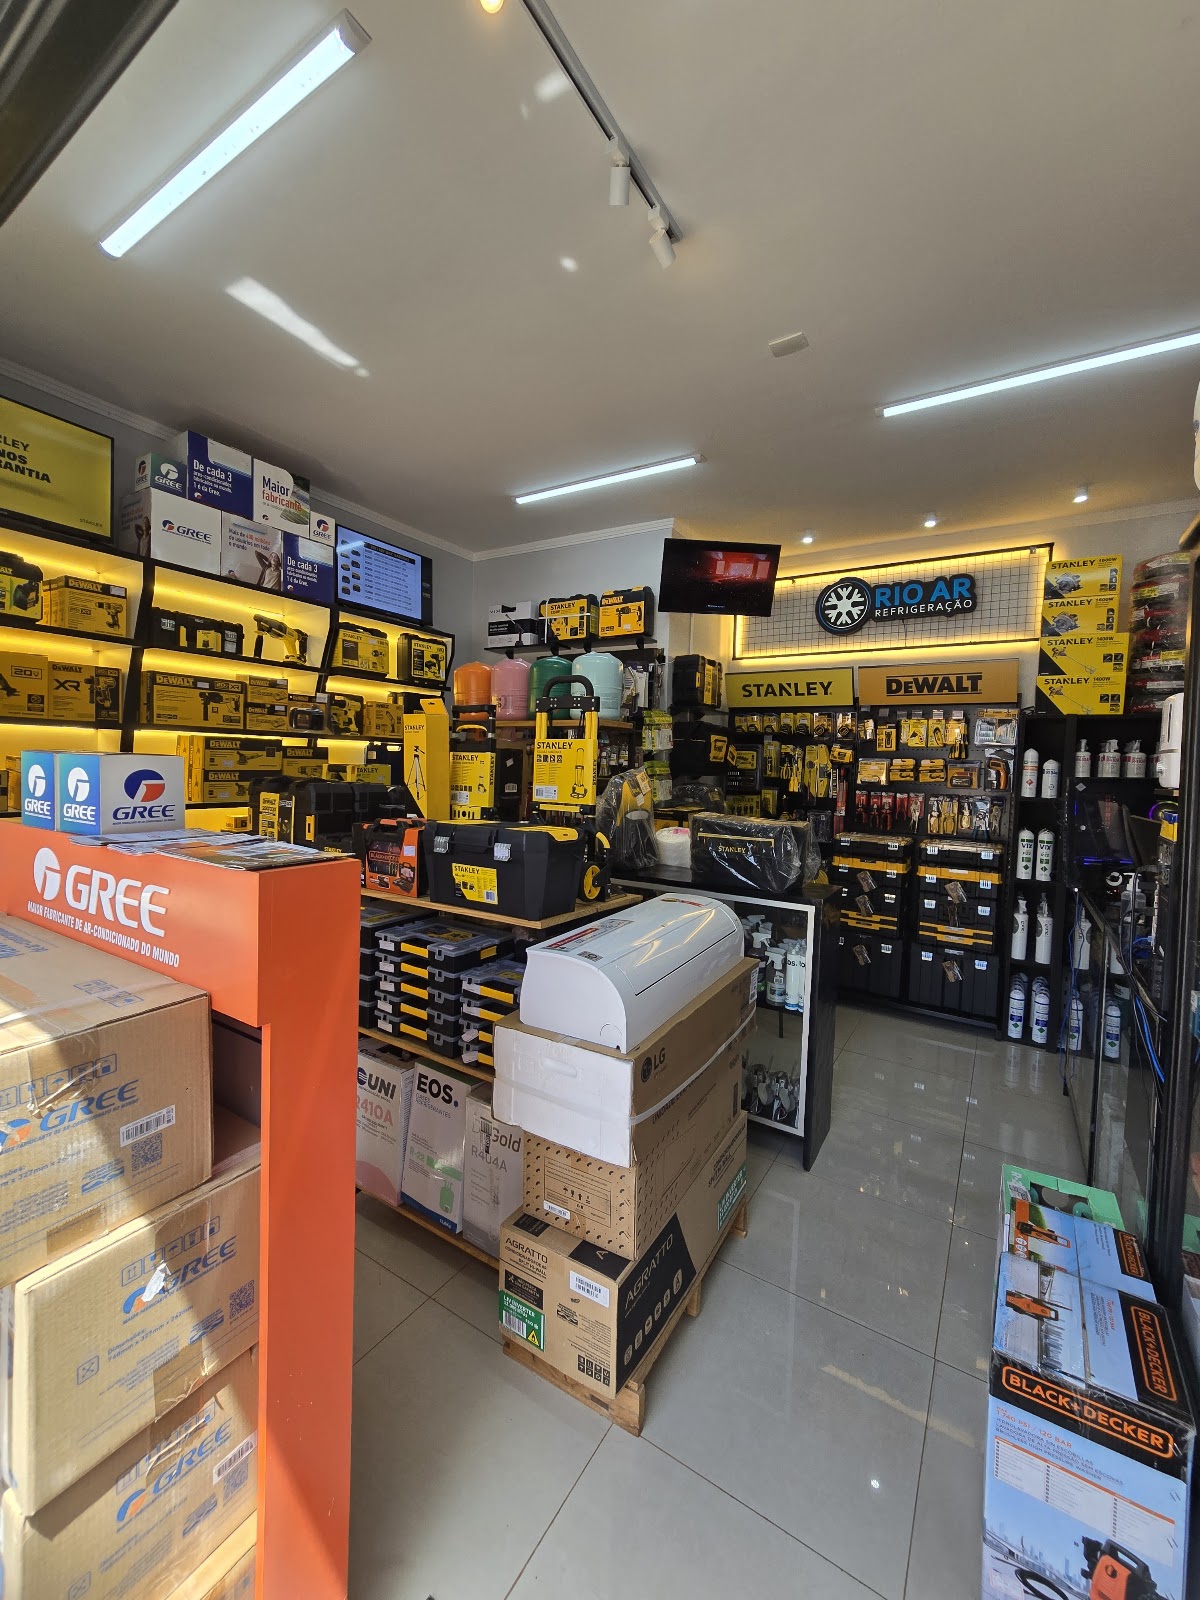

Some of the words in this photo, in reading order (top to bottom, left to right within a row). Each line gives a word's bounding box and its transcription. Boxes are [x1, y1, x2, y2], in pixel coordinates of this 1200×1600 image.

[193, 459, 205, 472] De
[206, 467, 225, 480] cada
[227, 472, 232, 482] 3
[154, 475, 183, 490] GREE
[262, 475, 290, 497] Maior
[262, 489, 302, 513] fabricante
[176, 525, 213, 542] GREE
[287, 556, 296, 567] De
[297, 562, 312, 573] cada
[313, 564, 318, 573] 3
[1051, 560, 1095, 570] STANLEY
[69, 578, 103, 593] DEWALT
[875, 582, 923, 608] RIO
[930, 577, 971, 601] AR
[550, 602, 576, 611] STANLEY
[874, 598, 973, 617] REFRIGERAÇÃO
[1048, 599, 1093, 609] STANLEY
[1047, 637, 1093, 647] STANLEY
[52, 664, 83, 674] DEWALT
[54, 678, 81, 691] XR
[156, 675, 194, 687] DEWALT
[250, 679, 270, 688] DEWALT
[741, 680, 834, 698] STANLEY
[885, 674, 983, 696] DEWALT
[1044, 677, 1090, 685] STANLEY
[249, 707, 268, 715] DEWALT
[209, 740, 242, 749] DEWALT
[286, 749, 314, 757] DEWALT
[536, 741, 574, 750] STANLEY
[208, 772, 240, 781] DEWALT
[24, 798, 52, 815] GREE
[63, 803, 97, 821] GREE
[112, 804, 176, 821] GREE
[718, 844, 747, 854] STANLEY
[454, 865, 480, 875] STANLEY
[66, 864, 170, 938] GREE
[27, 900, 43, 917] MAIOR
[44, 908, 75, 930] FABRICANTE
[75, 918, 83, 931] DE
[83, 920, 140, 953] AR-CONDICIONADO
[141, 941, 151, 956] DO
[152, 945, 180, 968] MUNDO
[654, 1046, 666, 1070] LG
[367, 1073, 397, 1100] UNI
[39, 1079, 140, 1132] GREE
[505, 1237, 548, 1264] AGRATTO
[625, 1233, 674, 1309] AGRATTO
[1138, 1310, 1167, 1394] BLACK+DECKER
[1009, 1373, 1165, 1450] BLACK+DECKER
[1039, 1429, 1053, 1439] 120
[1054, 1437, 1073, 1449] BAR
[152, 1417, 233, 1495] GREE
[995, 1422, 1027, 1439] LAVADORA
[1095, 1467, 1124, 1486] ESCOVAS
[1056, 1444, 1094, 1466] ESCOBILLAS
